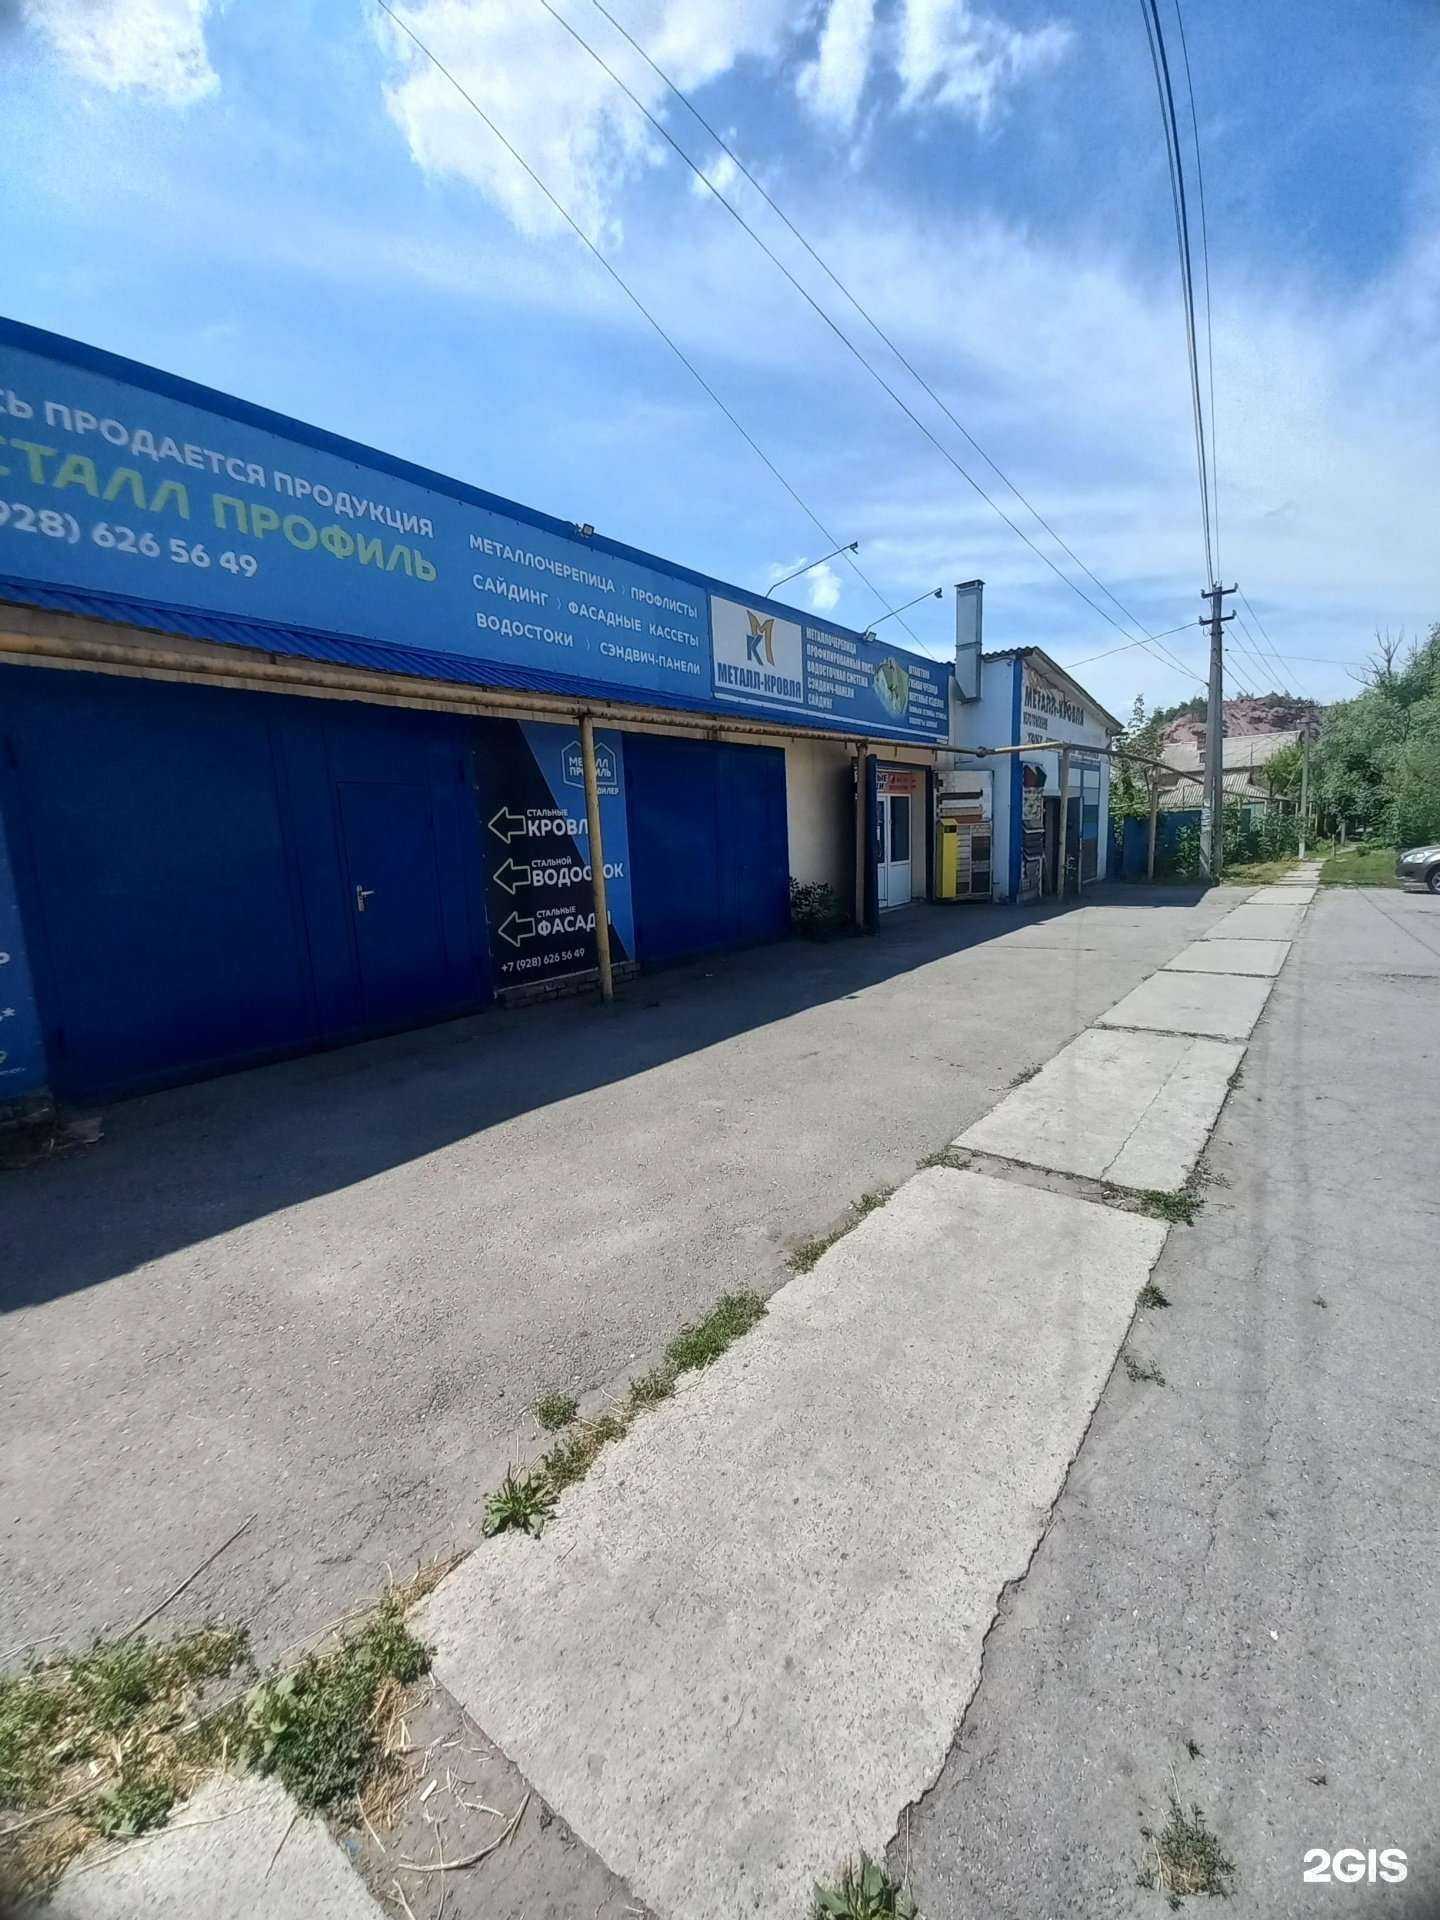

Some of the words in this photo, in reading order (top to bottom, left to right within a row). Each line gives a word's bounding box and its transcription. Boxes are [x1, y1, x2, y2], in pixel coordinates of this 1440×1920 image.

[45, 400, 267, 488] ПРОДАЕТСЯ
[274, 471, 434, 538] ПРОДУКЦИЯ
[91, 522, 160, 558] 626
[169, 539, 210, 568] 56
[219, 551, 258, 578] 49
[212, 493, 438, 582] ПРОФИЛЬ
[469, 534, 616, 593] МЕТАЛЛОЧЕРЕПИЦА
[631, 587, 698, 618] ПРОФЛИСТЫ
[473, 574, 549, 607] САЙДИНГ
[568, 601, 642, 632] ФАСАДНЫЕ
[649, 623, 699, 647] КАССЕТЫ
[476, 612, 574, 647] ВОДОСТОКИ
[600, 641, 701, 675] СЭНДВИЧ-ПАНЕЛИ
[717, 662, 801, 699] МЕТАЛЛ-КРОВЛЯ
[527, 808, 568, 817] СТАЛЬНЫЕ
[528, 818, 589, 837] КРОВЛ
[531, 856, 572, 868] СТАЛЬНОЙ
[532, 863, 624, 888] ВОДОСОК
[536, 905, 576, 918] СТАЛЬНЫЕ
[501, 962, 514, 972] +7
[516, 956, 542, 971] (928)
[543, 953, 560, 965] 626
[561, 950, 573, 961] 56
[573, 947, 585, 958] 49
